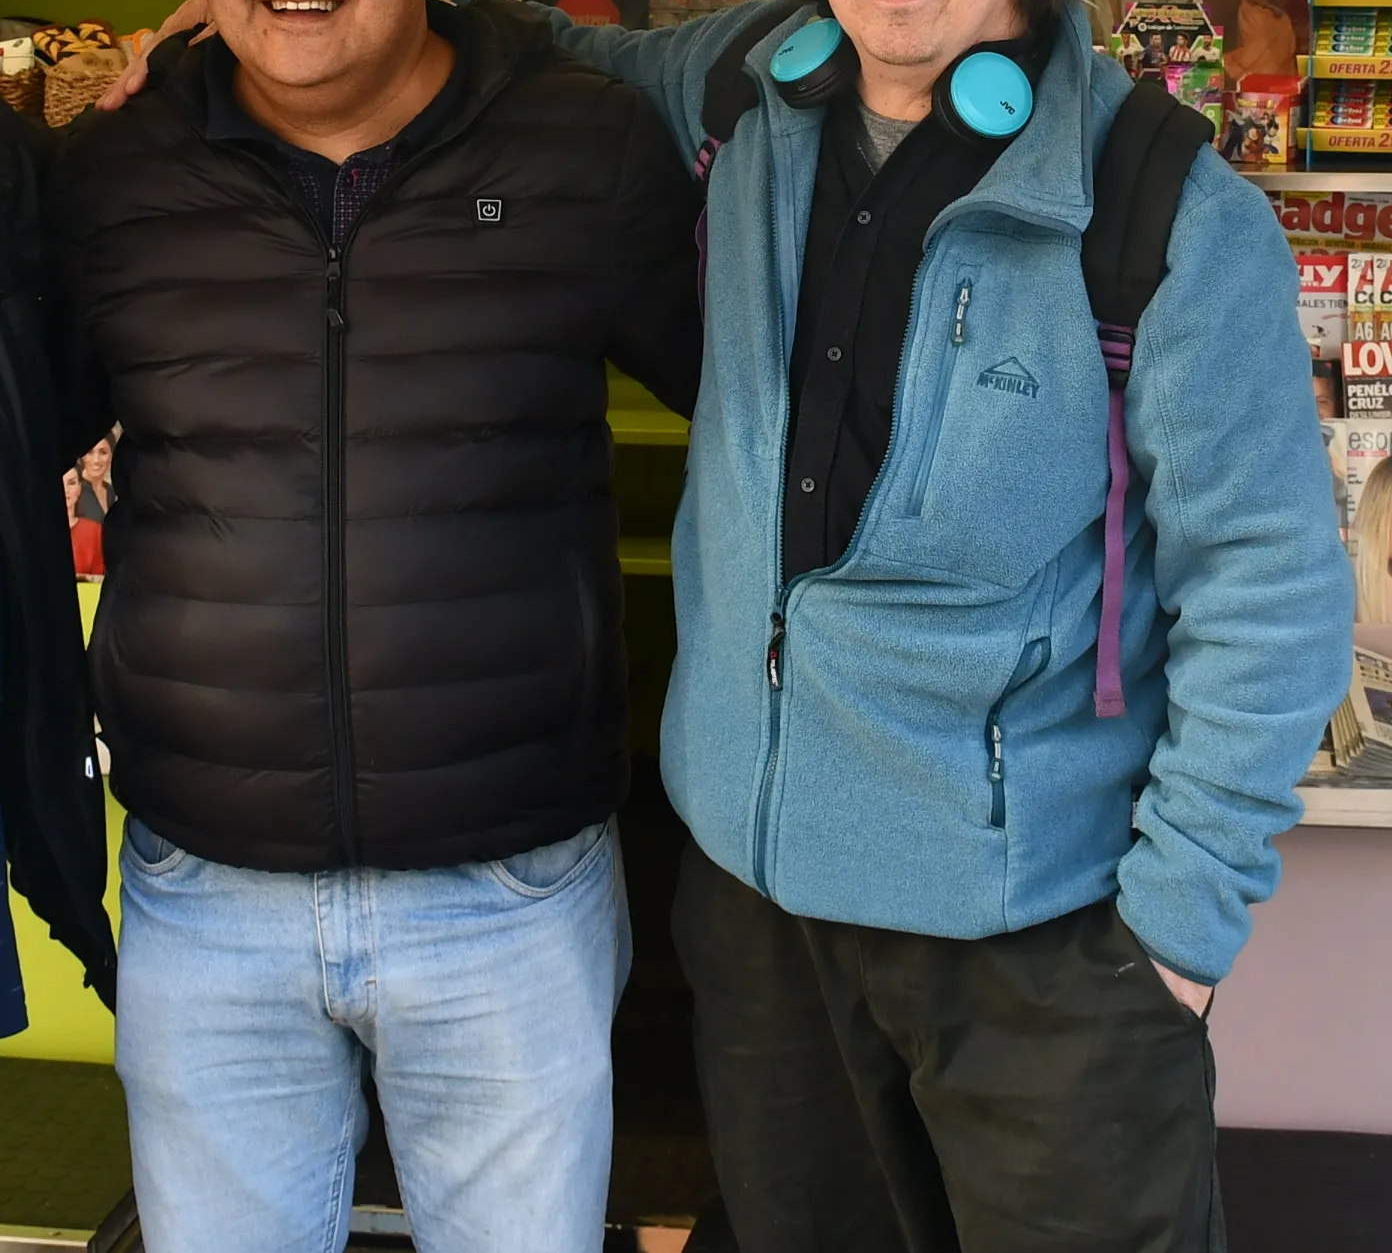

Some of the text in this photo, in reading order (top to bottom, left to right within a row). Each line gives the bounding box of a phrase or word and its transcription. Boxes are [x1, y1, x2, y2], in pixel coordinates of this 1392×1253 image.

[1329, 62, 1376, 75] OFERTA
[998, 99, 1016, 115] JVC
[1328, 135, 1376, 148] OFERTA
[1355, 322, 1374, 340] A6
[1348, 398, 1384, 410] CRUZ
